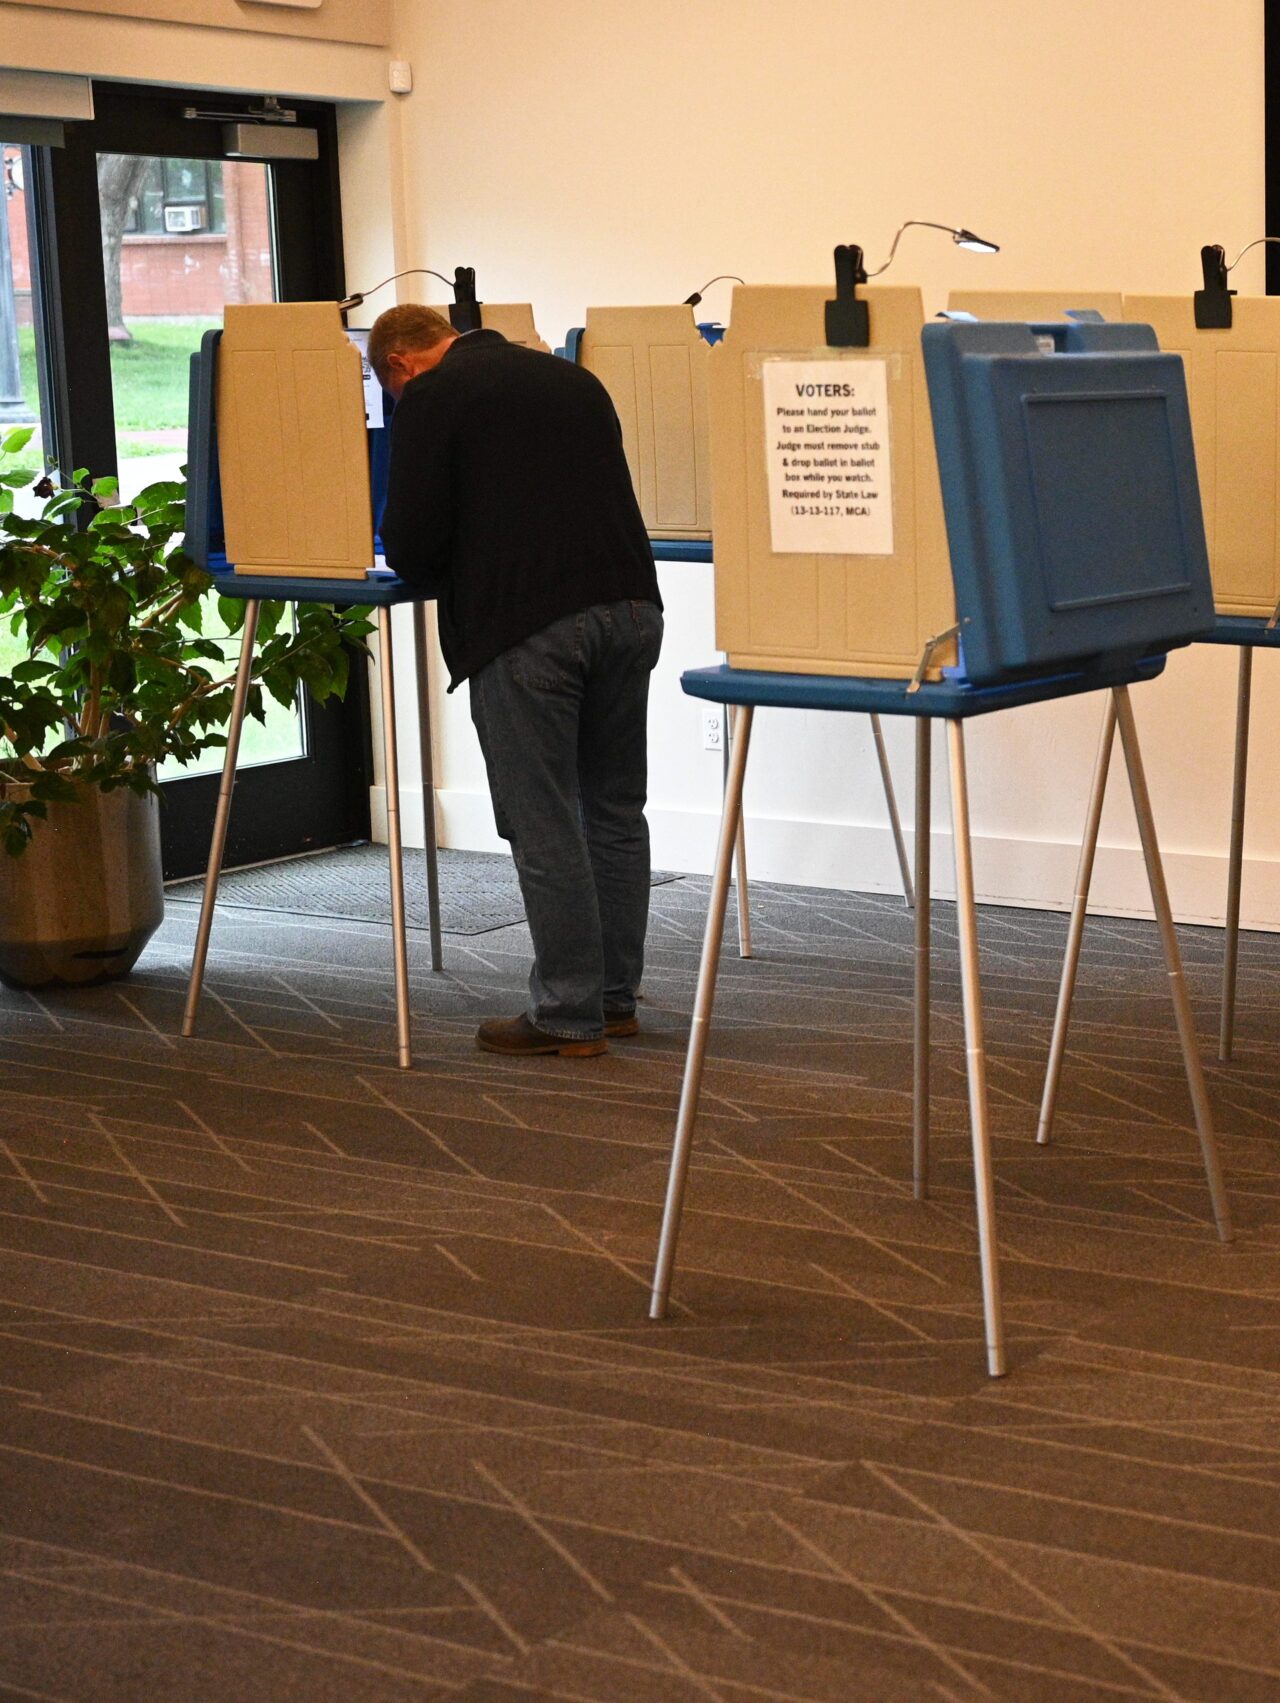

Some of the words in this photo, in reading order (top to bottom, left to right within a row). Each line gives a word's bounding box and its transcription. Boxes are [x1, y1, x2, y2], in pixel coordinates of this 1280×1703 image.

[796, 384, 855, 397] VOTERS:
[776, 408, 804, 416] Please
[807, 408, 828, 416] hand
[831, 408, 849, 419] your
[851, 408, 876, 416] ballot
[783, 425, 792, 433] to
[794, 425, 804, 433] an
[807, 424, 841, 433] Election
[844, 425, 871, 435] Judge.
[776, 442, 801, 452] Judge
[804, 442, 824, 450] must
[827, 442, 858, 450] remove
[861, 442, 880, 450] stub
[783, 458, 789, 467] &
[792, 458, 811, 469] drop
[813, 458, 838, 467] ballot
[840, 458, 848, 467] in
[851, 458, 875, 467] ballot
[785, 474, 800, 482] box
[804, 474, 824, 482] while
[827, 474, 842, 485] you
[845, 474, 873, 482] watch.
[782, 490, 820, 500] Required
[823, 490, 833, 500] by
[836, 490, 858, 498] State
[861, 490, 878, 498] Law
[792, 506, 844, 517] (13-13-117,
[846, 506, 870, 516] MCA)
